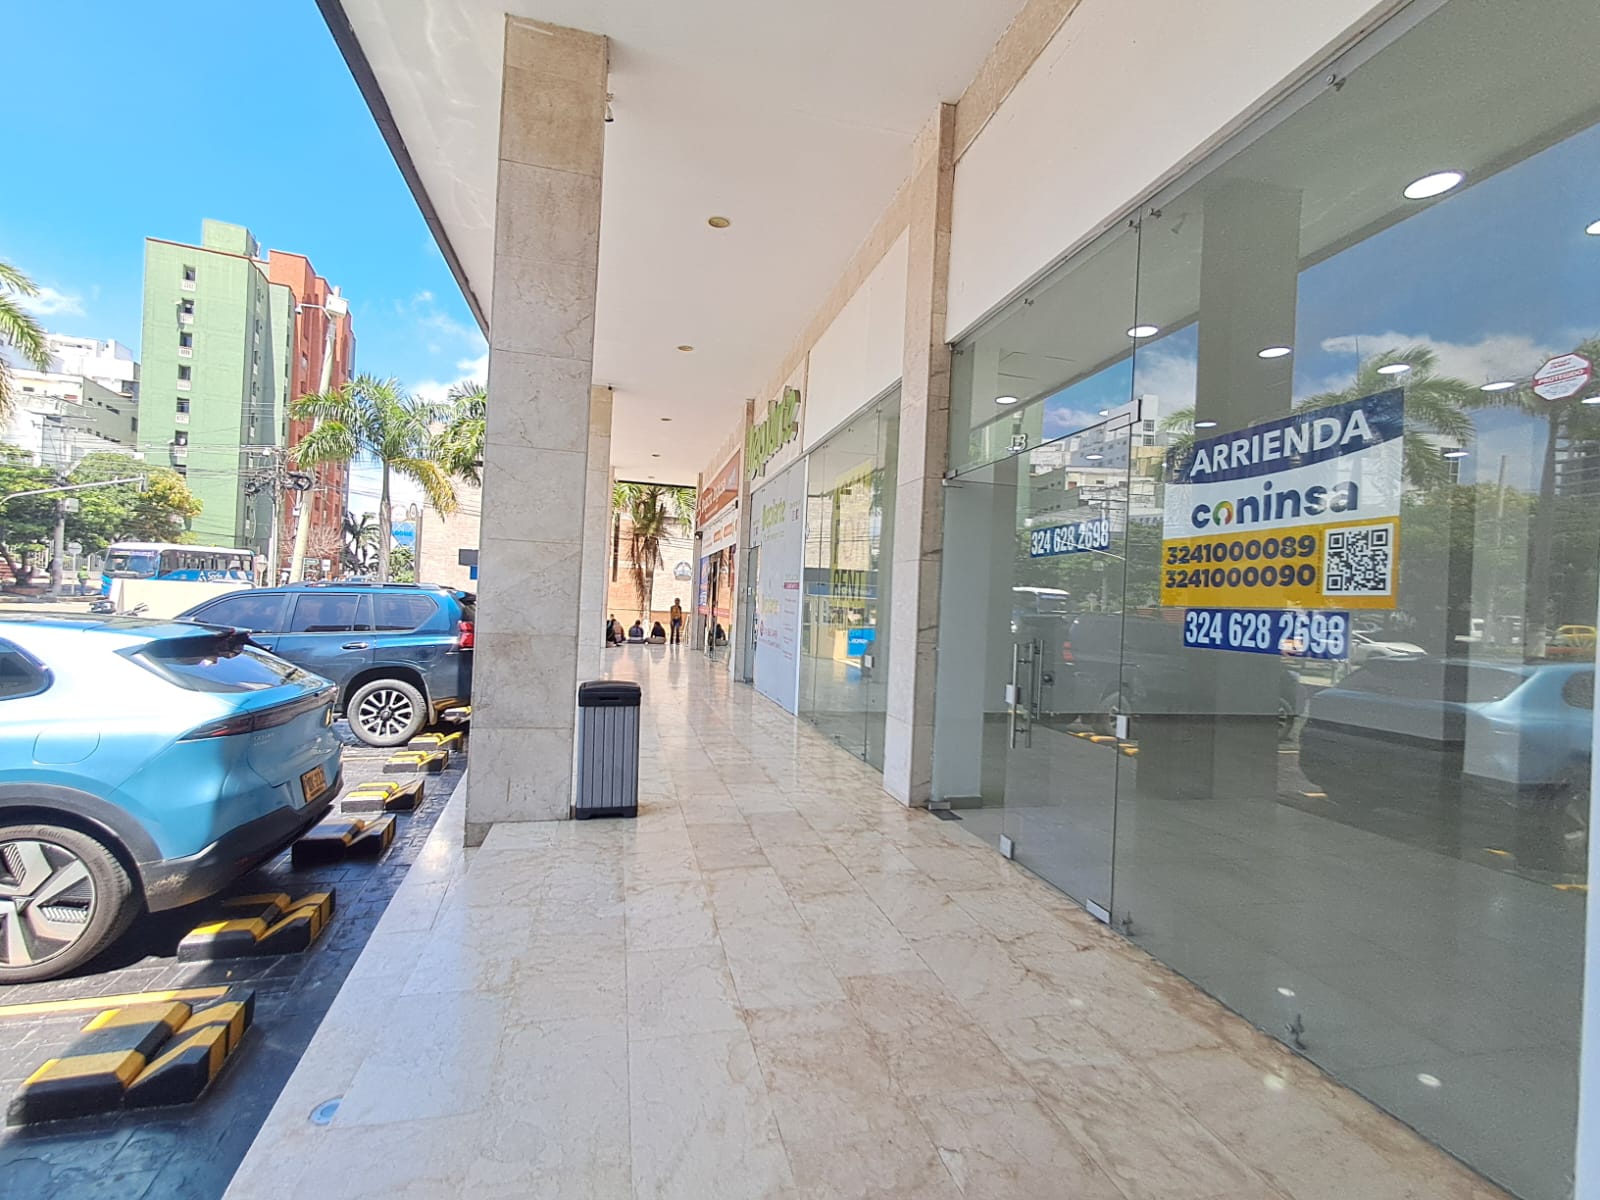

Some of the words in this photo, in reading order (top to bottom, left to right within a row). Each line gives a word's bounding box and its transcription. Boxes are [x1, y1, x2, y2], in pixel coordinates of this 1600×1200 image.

[1190, 409, 1373, 477] ARRIENDA
[1191, 480, 1359, 529] coninsa
[1031, 530, 1051, 555] 324
[1053, 526, 1076, 552] 628
[1077, 519, 1109, 549] 2698
[1166, 534, 1317, 565] 3241000089
[1165, 564, 1316, 588] 3241000090
[1185, 611, 1223, 645] 324
[1228, 612, 1271, 649] 628
[1277, 613, 1345, 655] 2698
